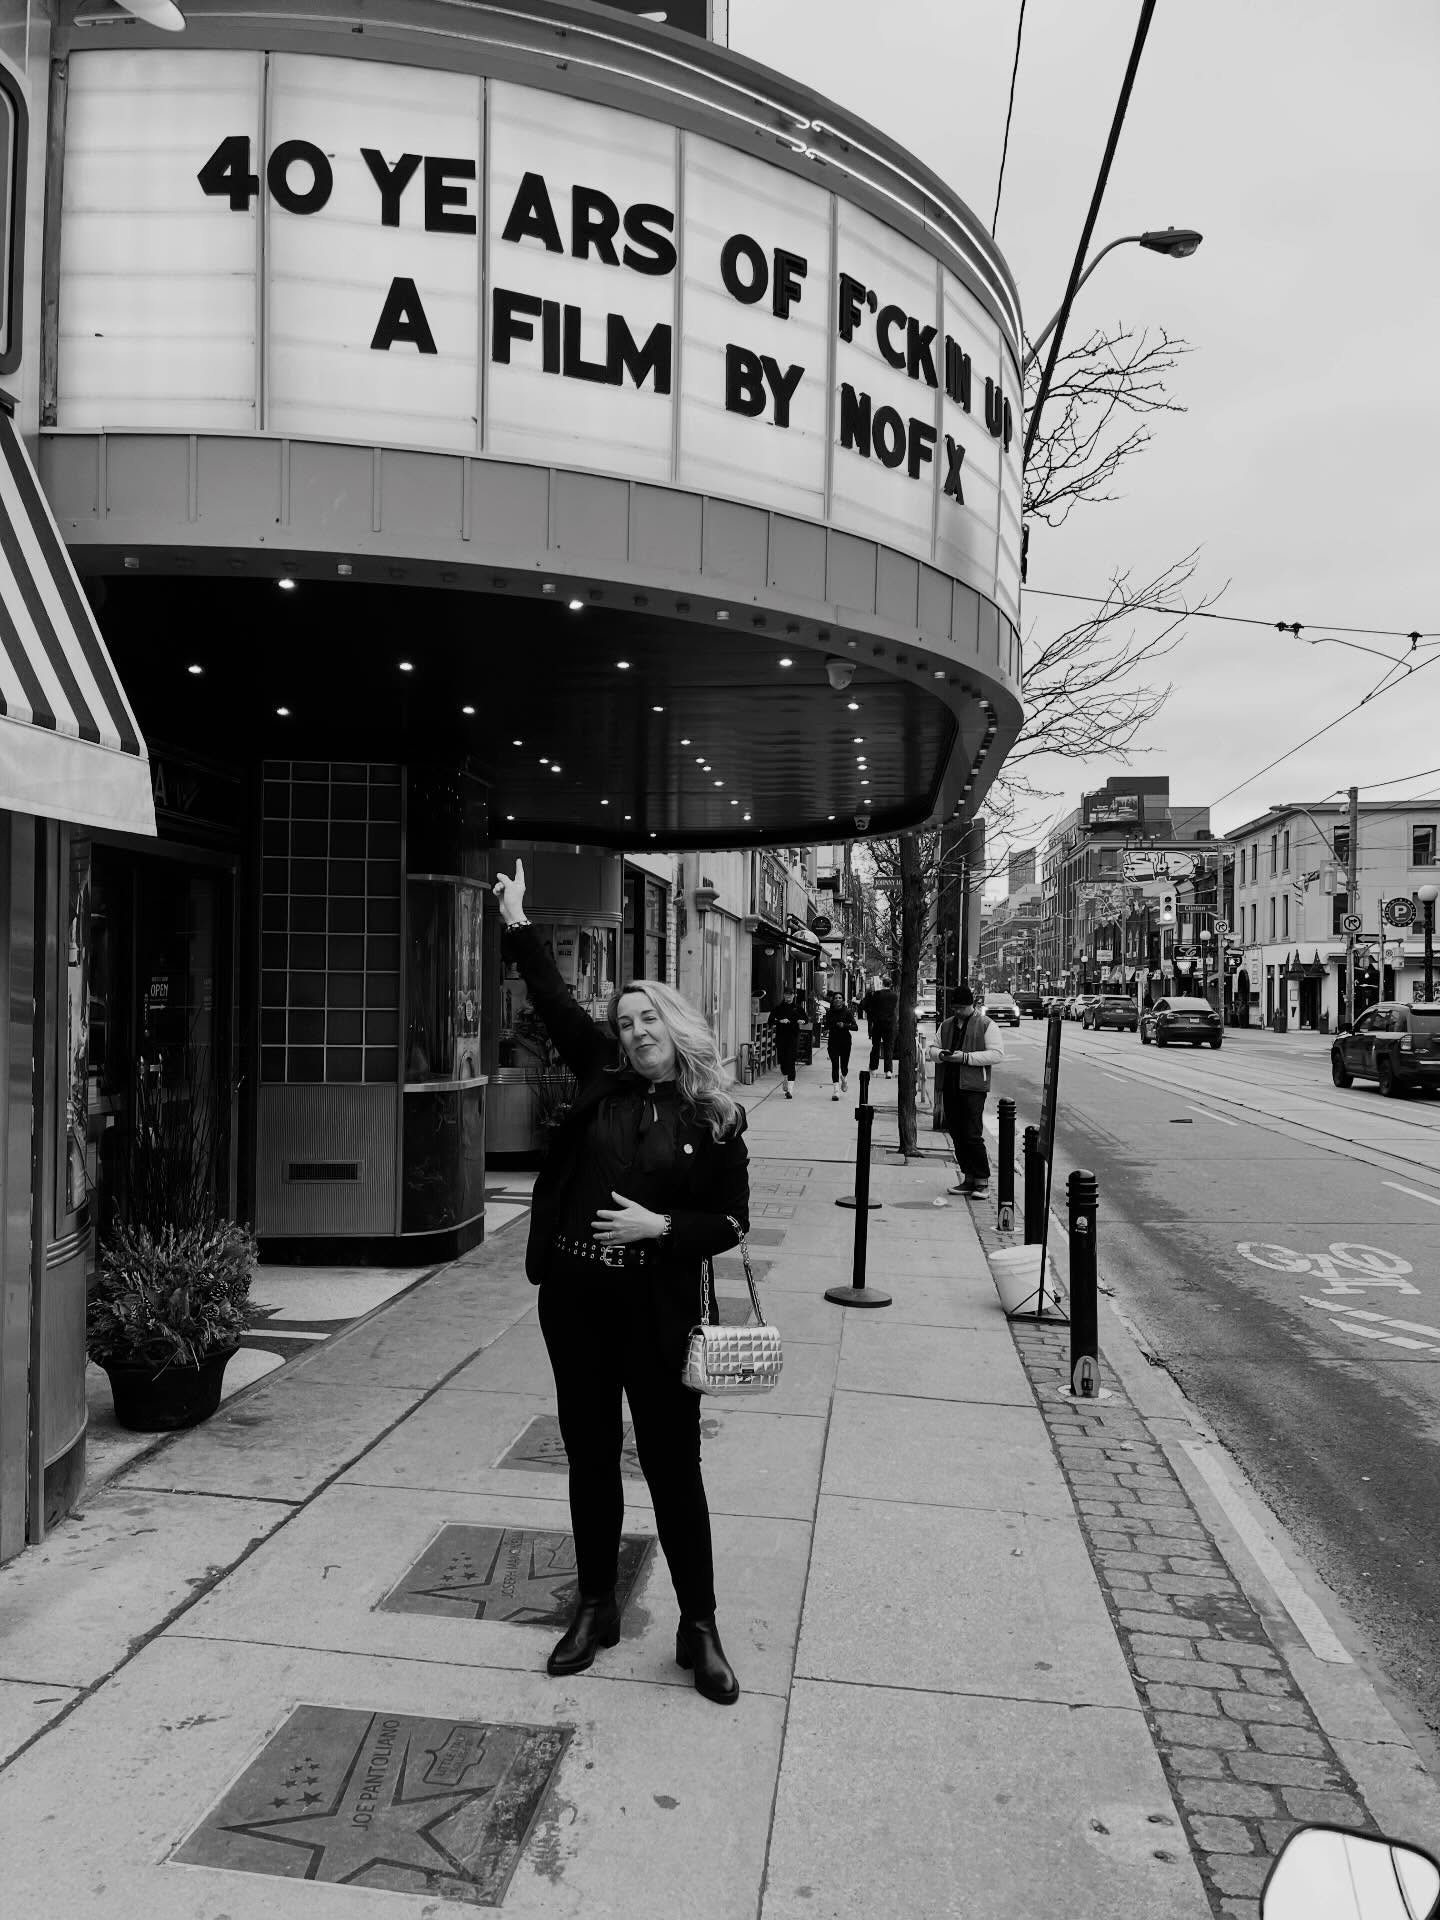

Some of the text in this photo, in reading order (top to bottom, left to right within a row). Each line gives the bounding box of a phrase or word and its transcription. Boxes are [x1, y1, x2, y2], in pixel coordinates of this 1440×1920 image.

[197, 135, 333, 214] 40
[359, 147, 677, 276] YEARS
[720, 233, 807, 320] OF
[984, 376, 1013, 454] UP
[370, 277, 438, 355] A
[492, 286, 672, 394] FILM
[725, 342, 805, 429] BY
[1394, 905, 1407, 918] P
[150, 984, 169, 997] OPEN
[350, 1719, 401, 1832] JOE PANTOLIANO
